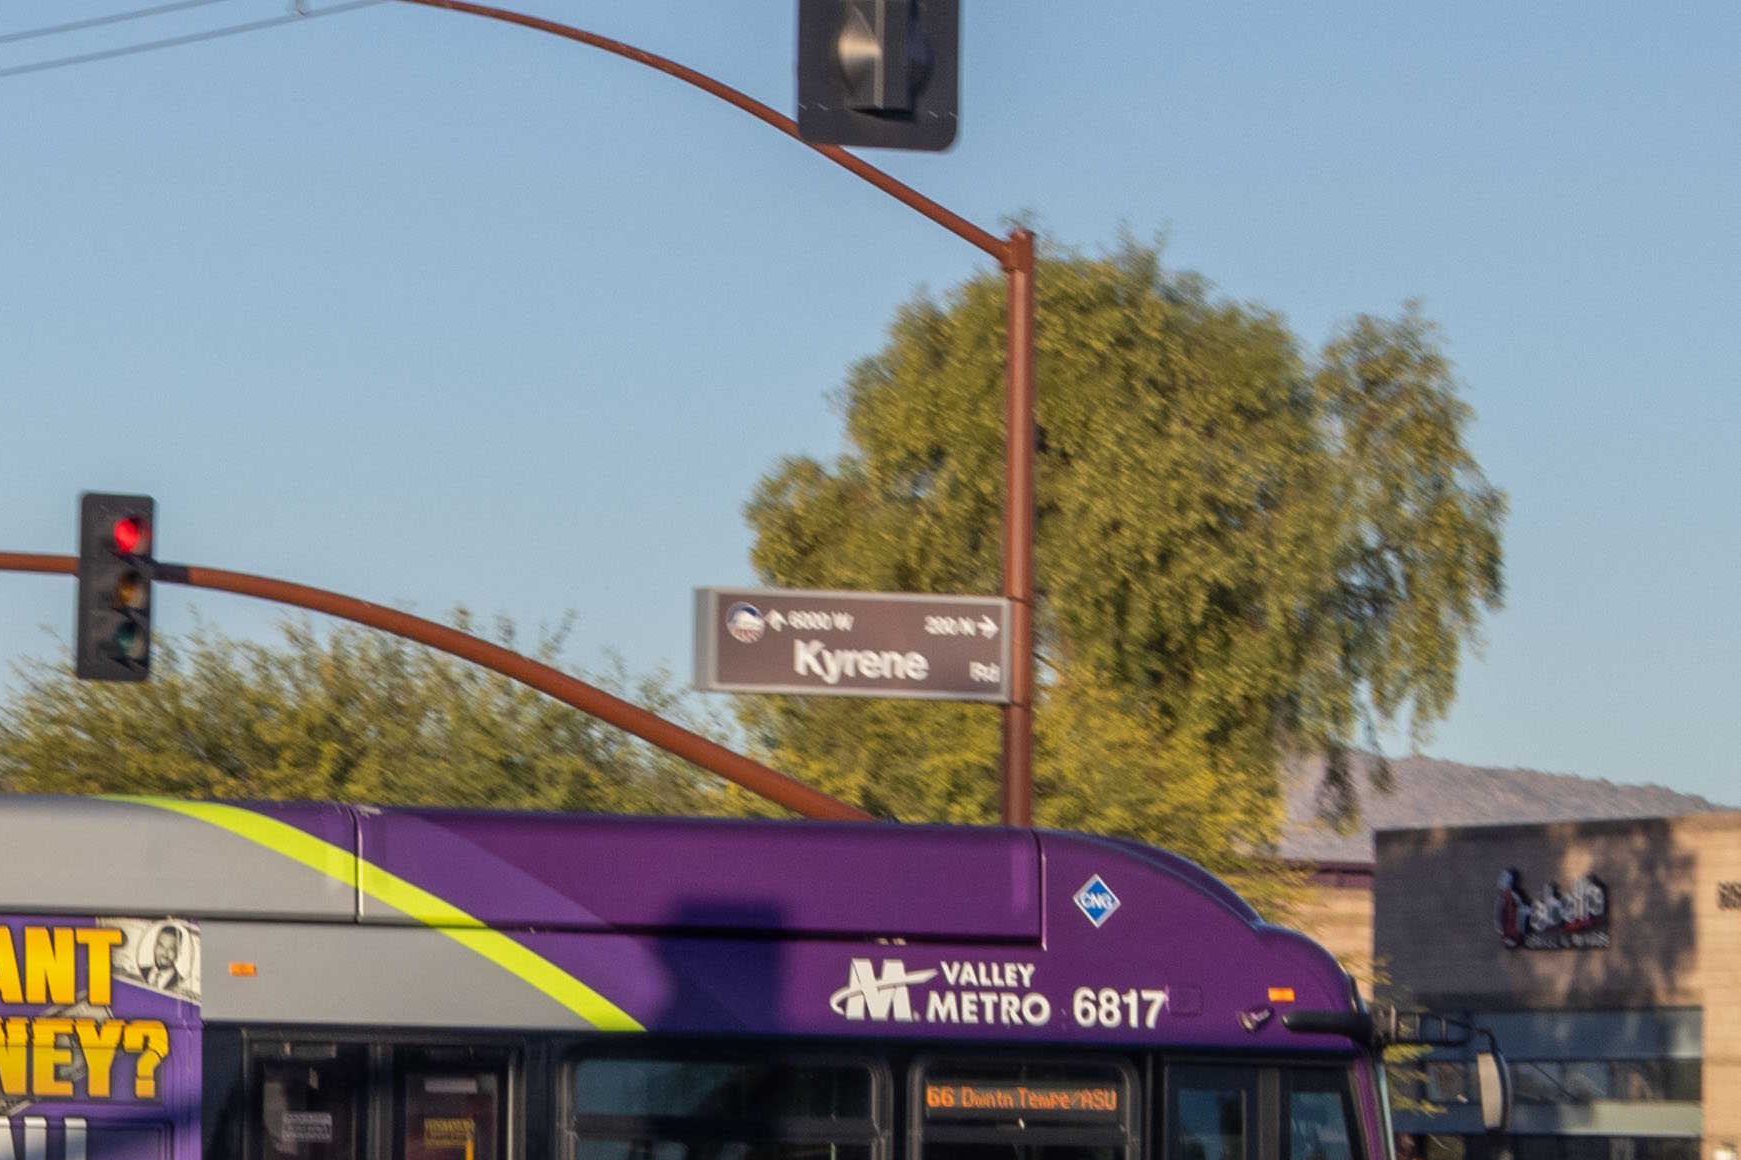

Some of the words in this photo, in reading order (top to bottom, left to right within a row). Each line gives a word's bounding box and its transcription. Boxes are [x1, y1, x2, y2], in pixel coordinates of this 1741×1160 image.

[832, 611, 855, 632] W
[794, 638, 929, 684] Kyrene
[969, 661, 1000, 683] Rd
[940, 960, 1036, 988] VALLEY
[926, 990, 1051, 1026] METRO
[1072, 986, 1167, 1029] 6817
[926, 1085, 955, 1109] 66
